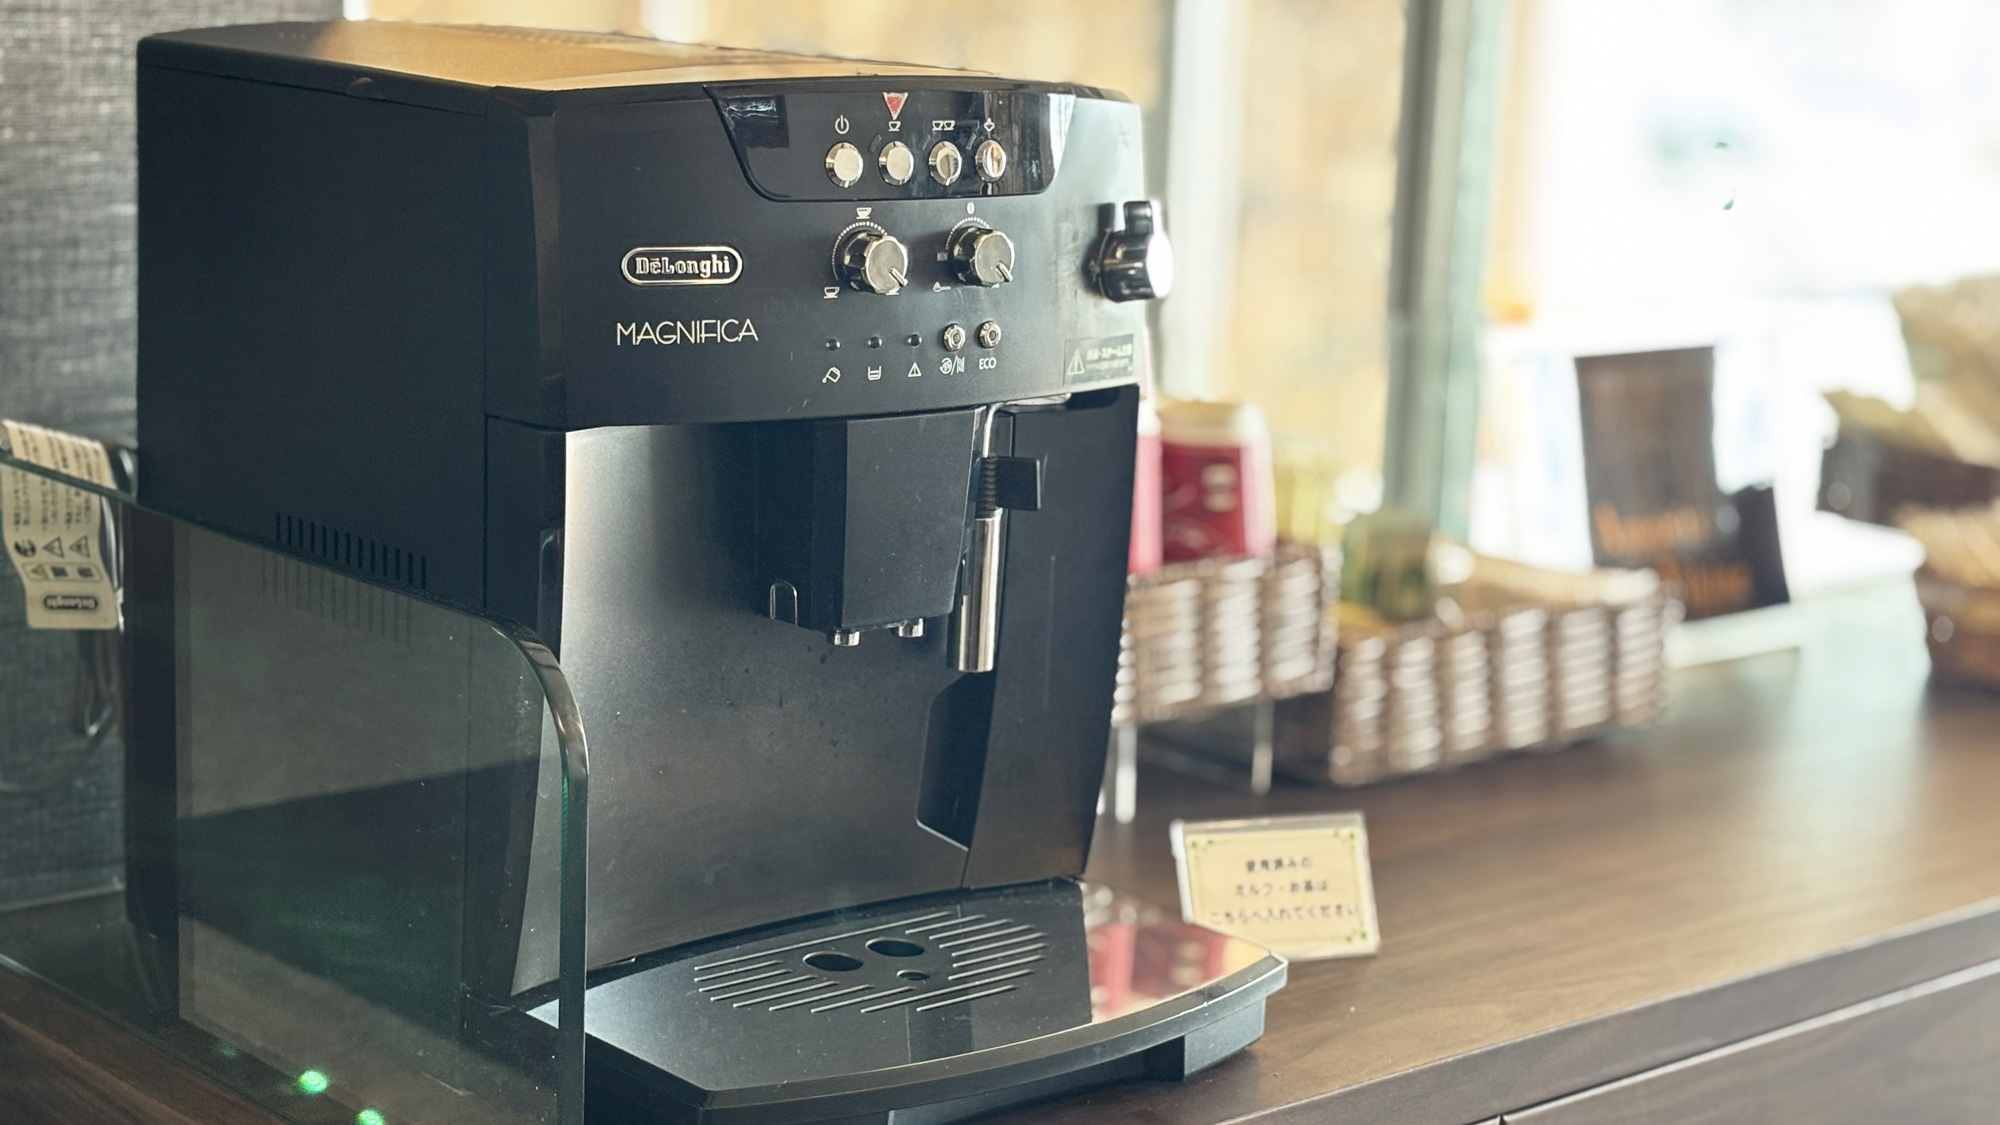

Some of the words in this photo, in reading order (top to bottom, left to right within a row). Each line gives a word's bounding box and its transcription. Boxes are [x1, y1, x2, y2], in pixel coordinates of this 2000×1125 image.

[616, 318, 759, 346] MAGNIFICA
[978, 356, 997, 370] ECO
[1209, 904, 1356, 926] こちらへ入れてください
